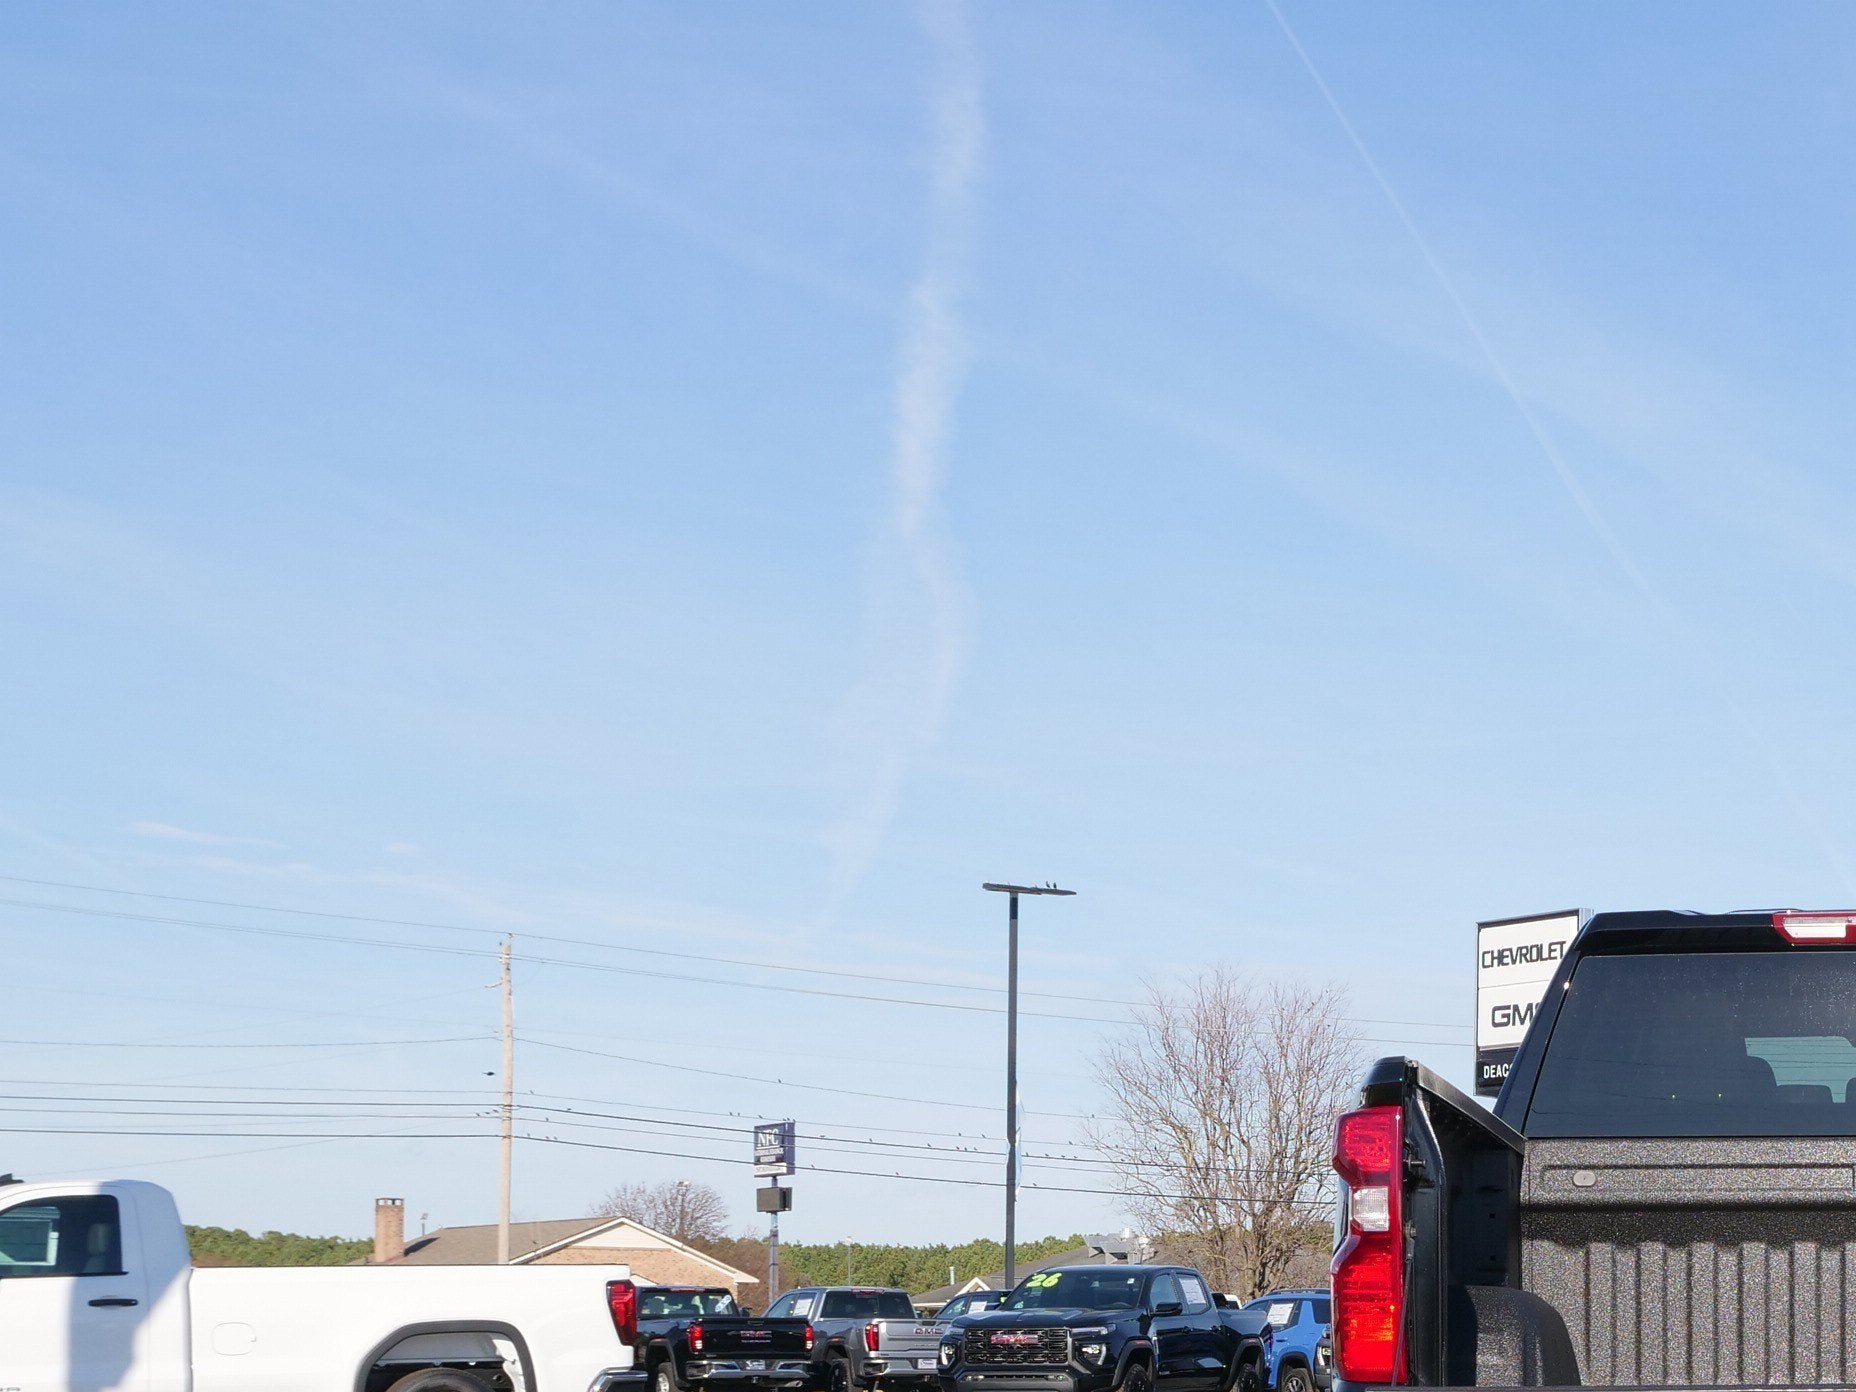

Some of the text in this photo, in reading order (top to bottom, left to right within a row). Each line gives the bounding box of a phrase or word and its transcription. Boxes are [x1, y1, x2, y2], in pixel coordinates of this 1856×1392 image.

[1481, 941, 1567, 969] CHEVROLET
[1491, 1002, 1541, 1028] GM
[1483, 1063, 1513, 1079] DEAC
[757, 1129, 779, 1147] NFC
[1026, 1272, 1062, 1288] 26
